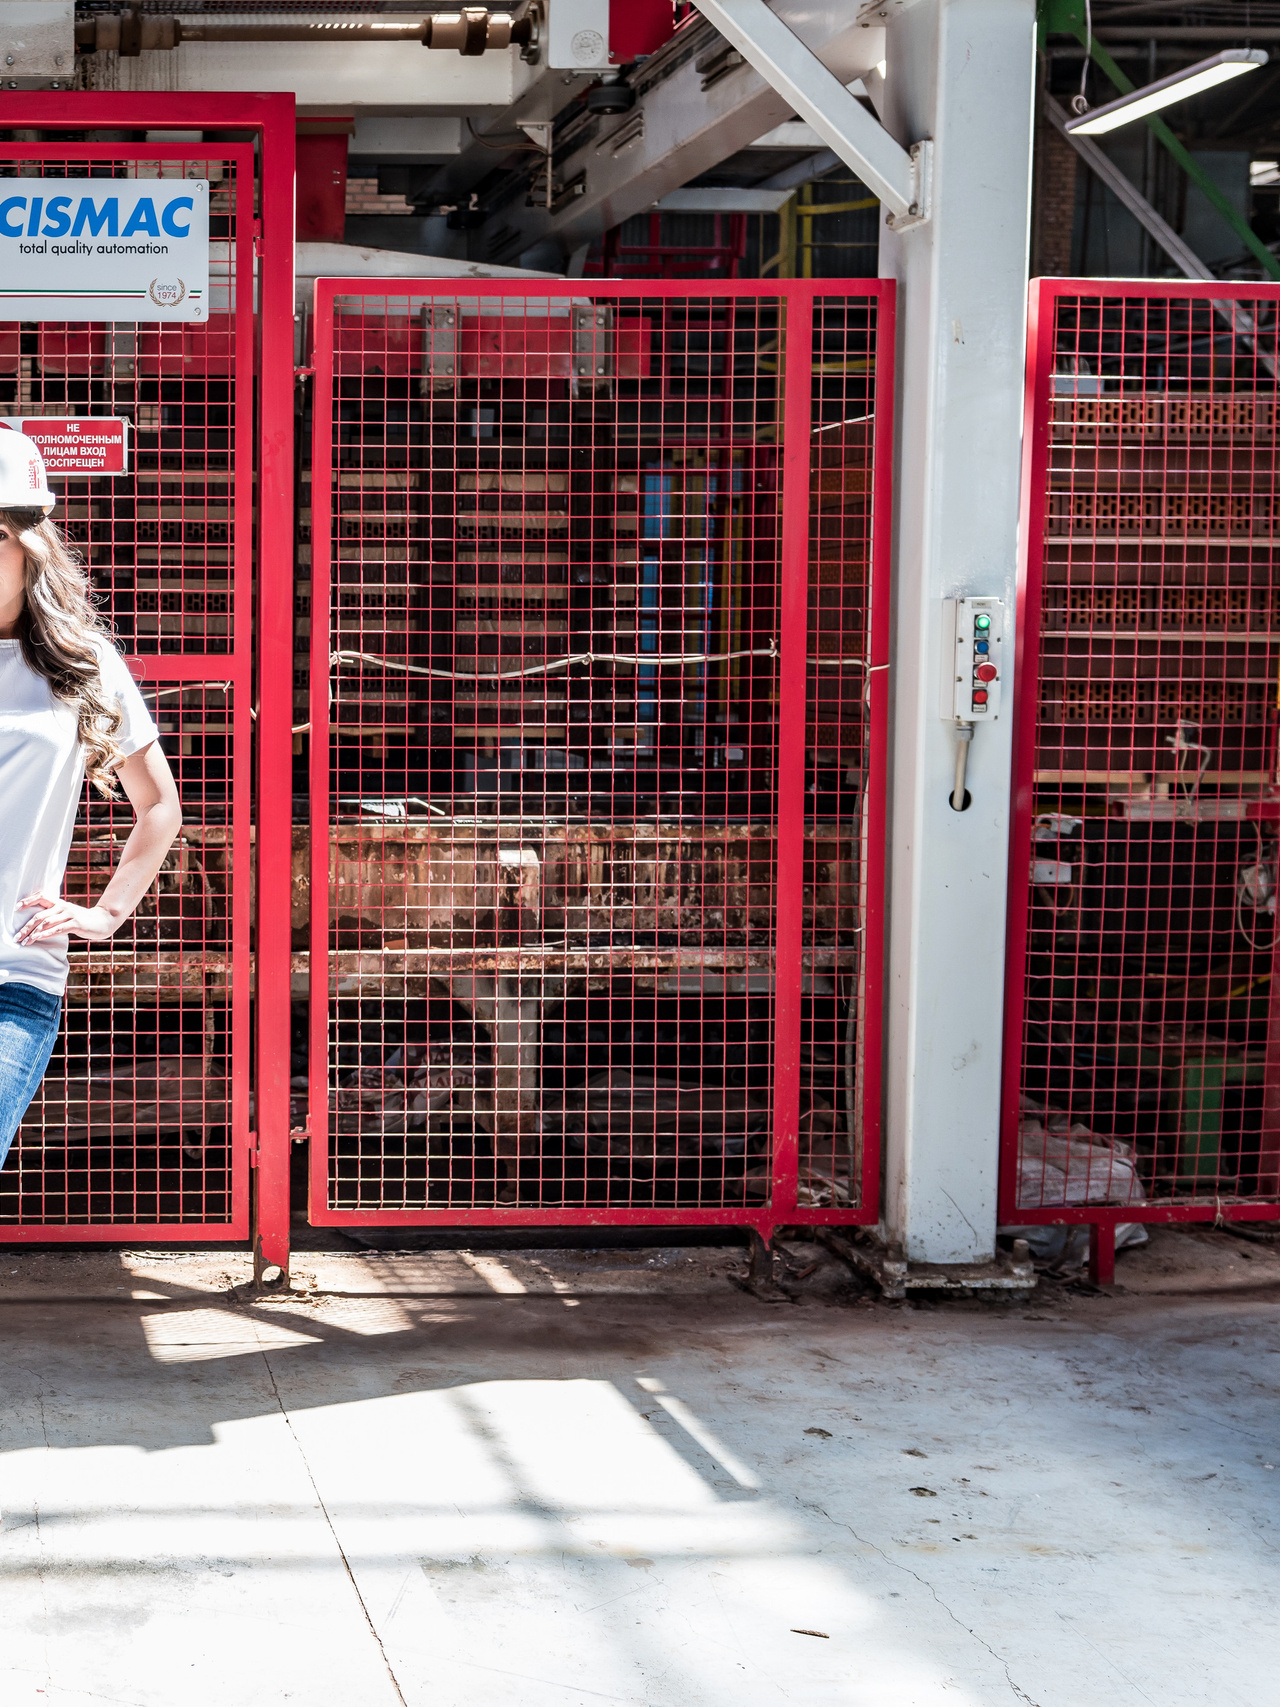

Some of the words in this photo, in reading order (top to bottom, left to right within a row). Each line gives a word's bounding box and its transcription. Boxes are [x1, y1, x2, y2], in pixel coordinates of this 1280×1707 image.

[19, 240, 47, 254] total
[51, 240, 93, 256] quality
[96, 242, 169, 254] automation
[157, 283, 177, 291] since
[158, 291, 177, 299] 1974
[66, 423, 80, 432] НЕ
[29, 435, 122, 444] ПОЛНОМОЧЕННЫМ
[43, 446, 78, 457] ЛИЦАМ
[80, 446, 107, 457] ВХОД
[44, 458, 104, 468] ВОСПРЕЩЕН
